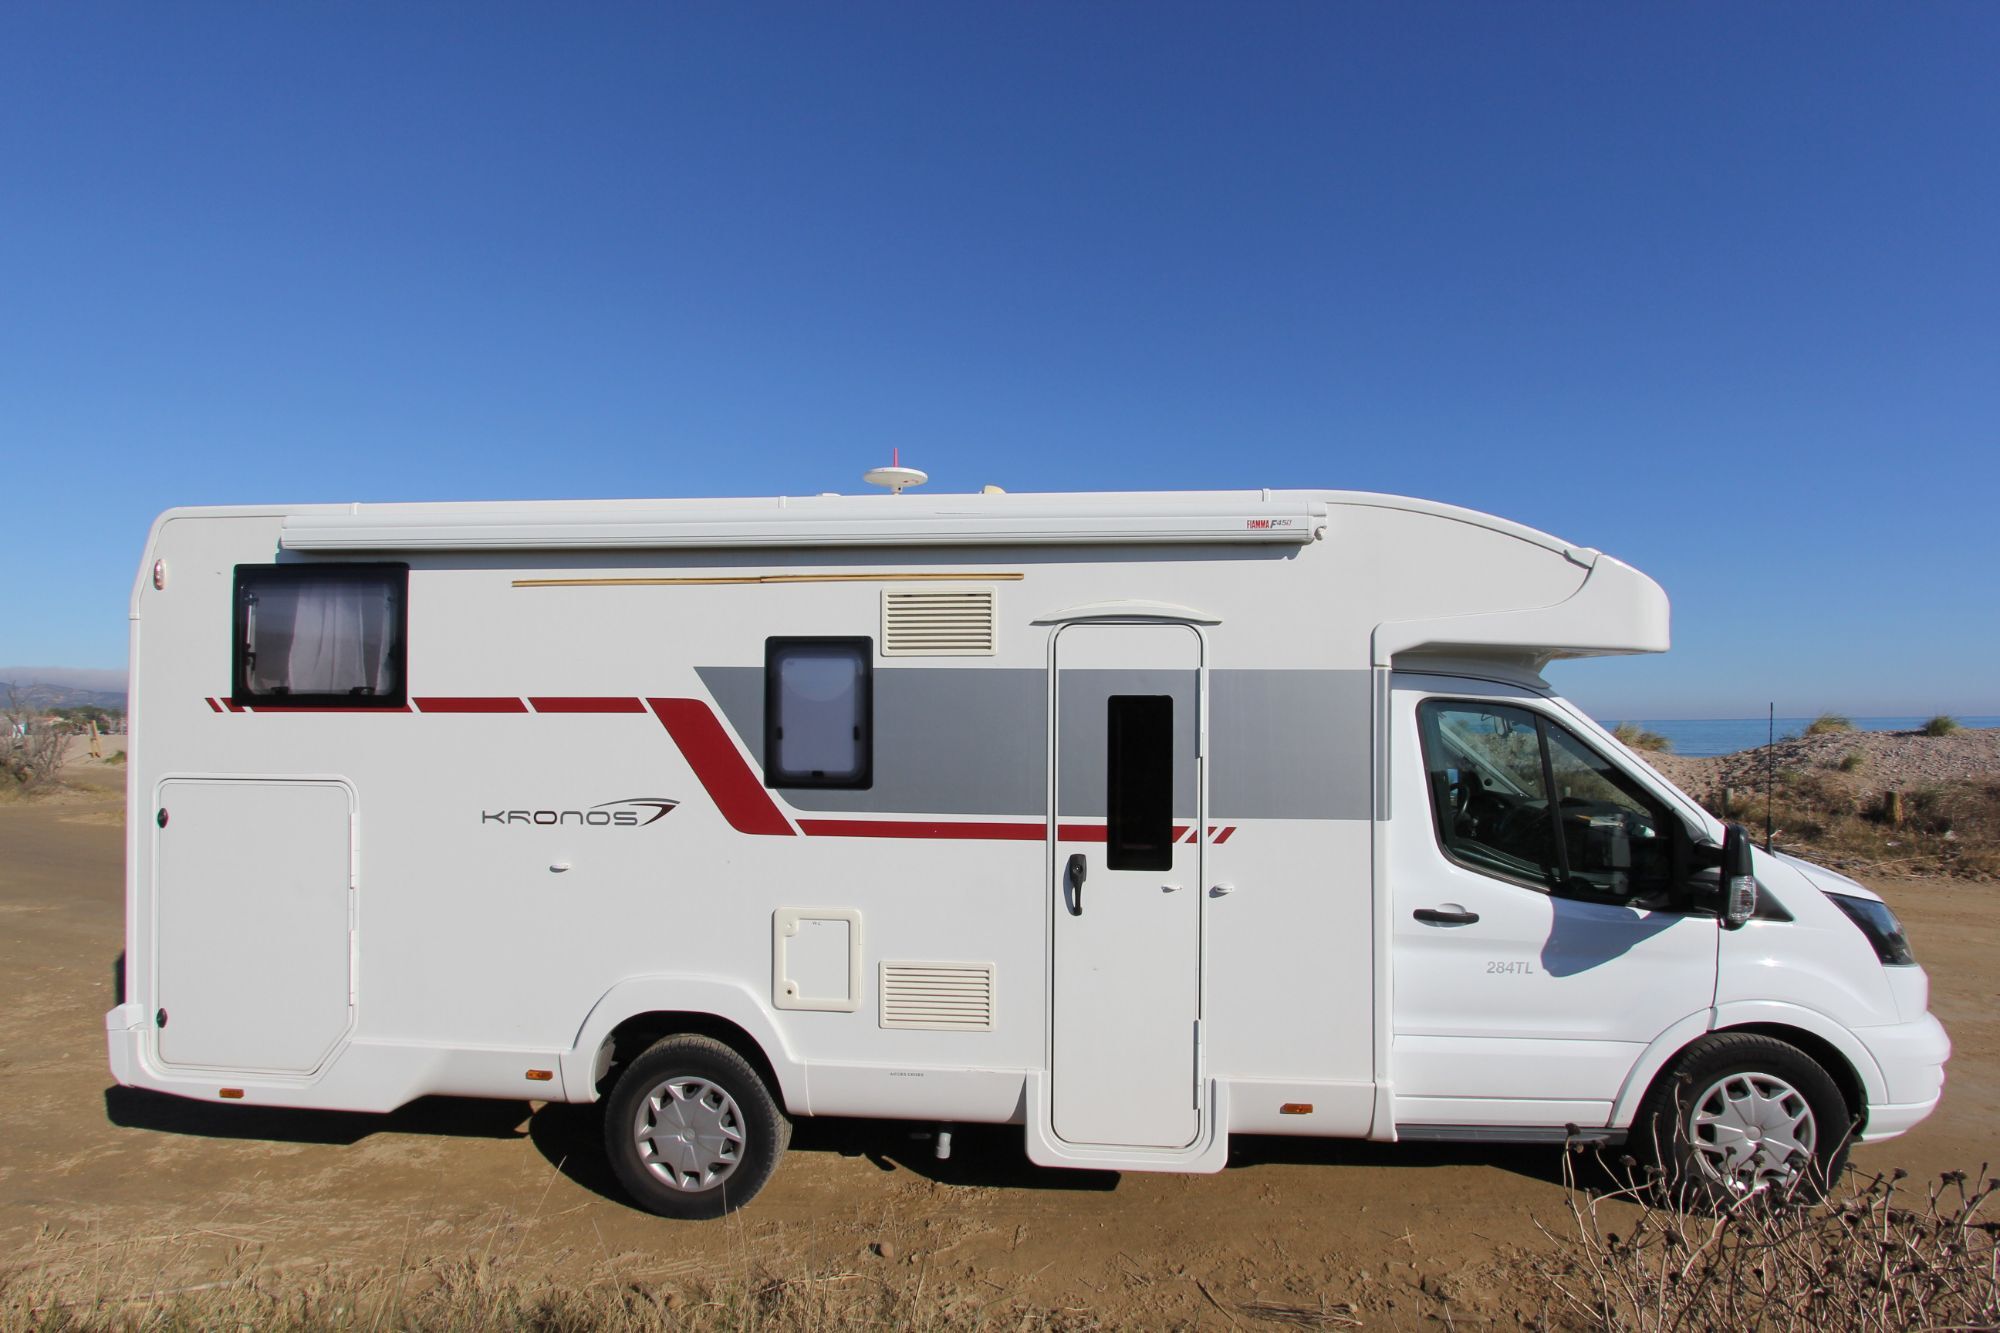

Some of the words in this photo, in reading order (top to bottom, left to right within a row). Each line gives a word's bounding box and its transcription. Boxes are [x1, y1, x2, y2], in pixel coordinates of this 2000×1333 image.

[1246, 519, 1270, 529] FIAMMA
[482, 810, 638, 826] KRONOS
[1486, 961, 1534, 974] 284TL
